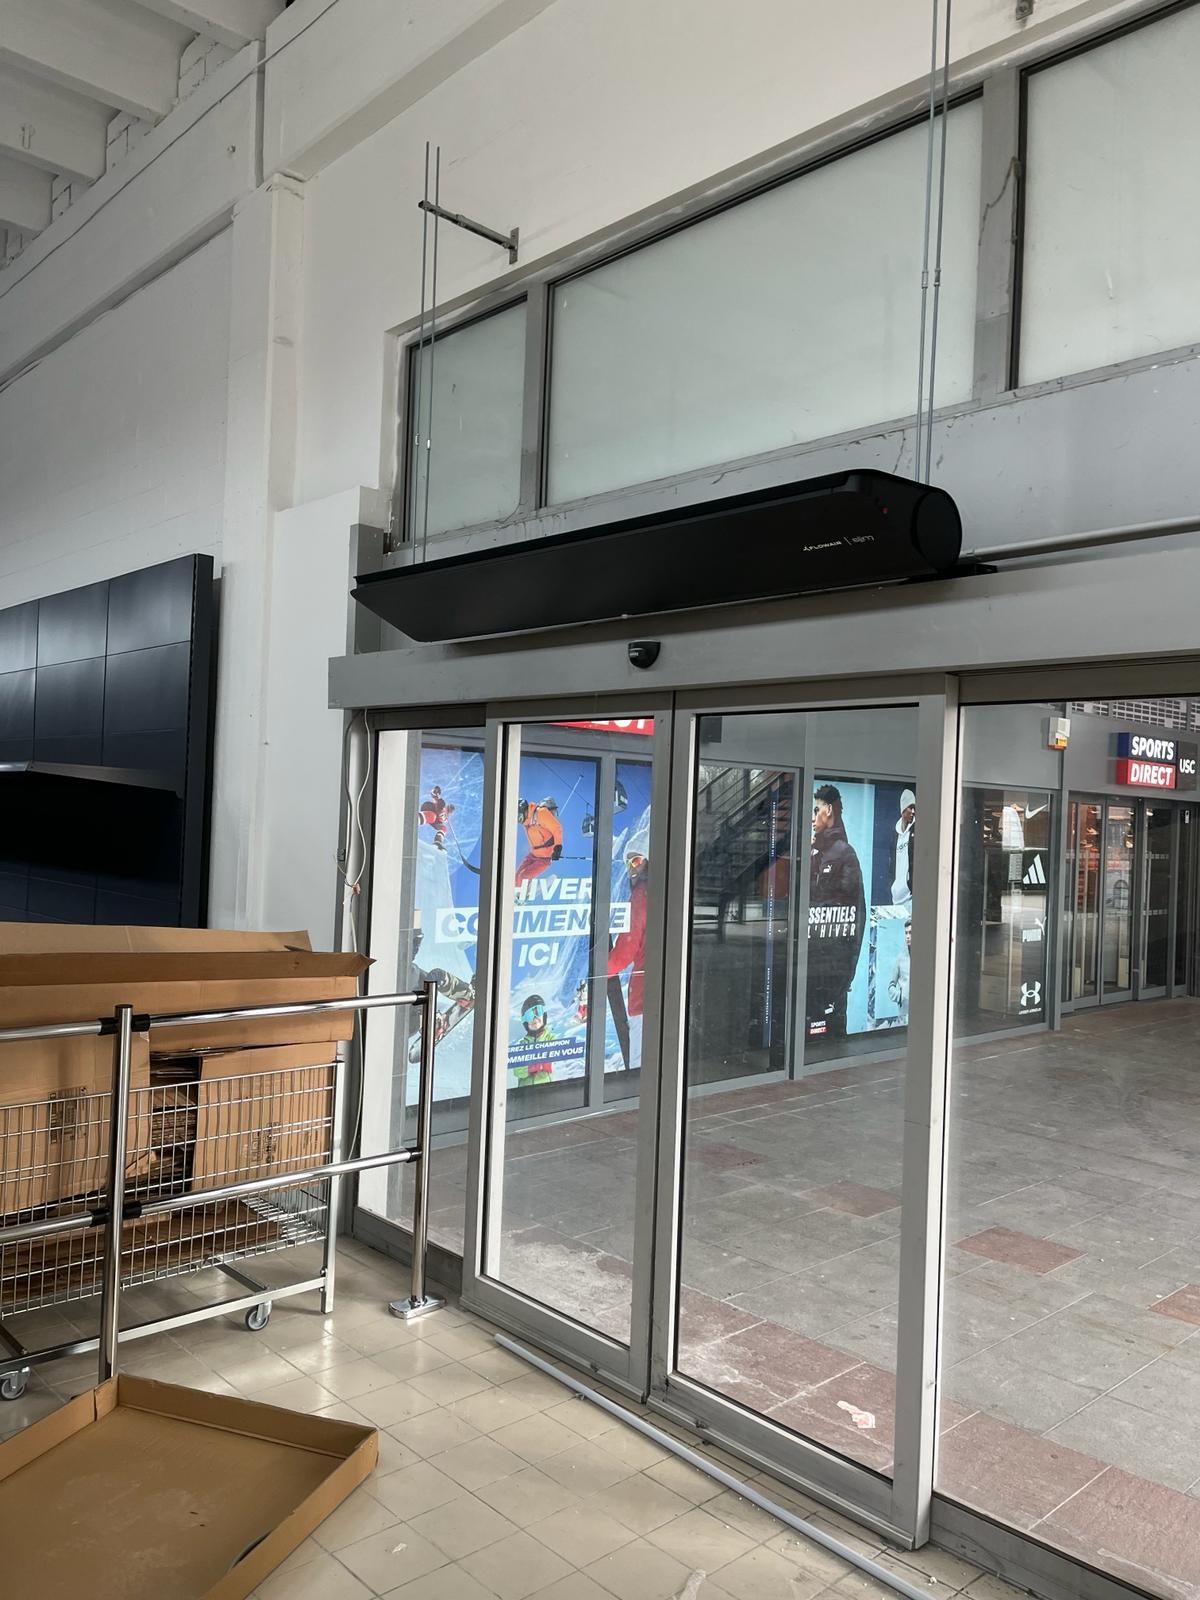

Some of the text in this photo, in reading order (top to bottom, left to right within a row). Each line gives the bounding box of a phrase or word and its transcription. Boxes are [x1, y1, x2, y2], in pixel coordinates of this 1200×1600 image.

[808, 541, 842, 550] FLOWAIR
[1131, 735, 1175, 760] SPORTS
[1130, 763, 1173, 786] DIRECT
[1179, 758, 1196, 774] USC
[441, 907, 627, 938] CMENE
[518, 942, 560, 968] ICI
[534, 1039, 570, 1050] CHAMPION
[549, 1050, 560, 1058] EN
[561, 1046, 583, 1056] VOUS
